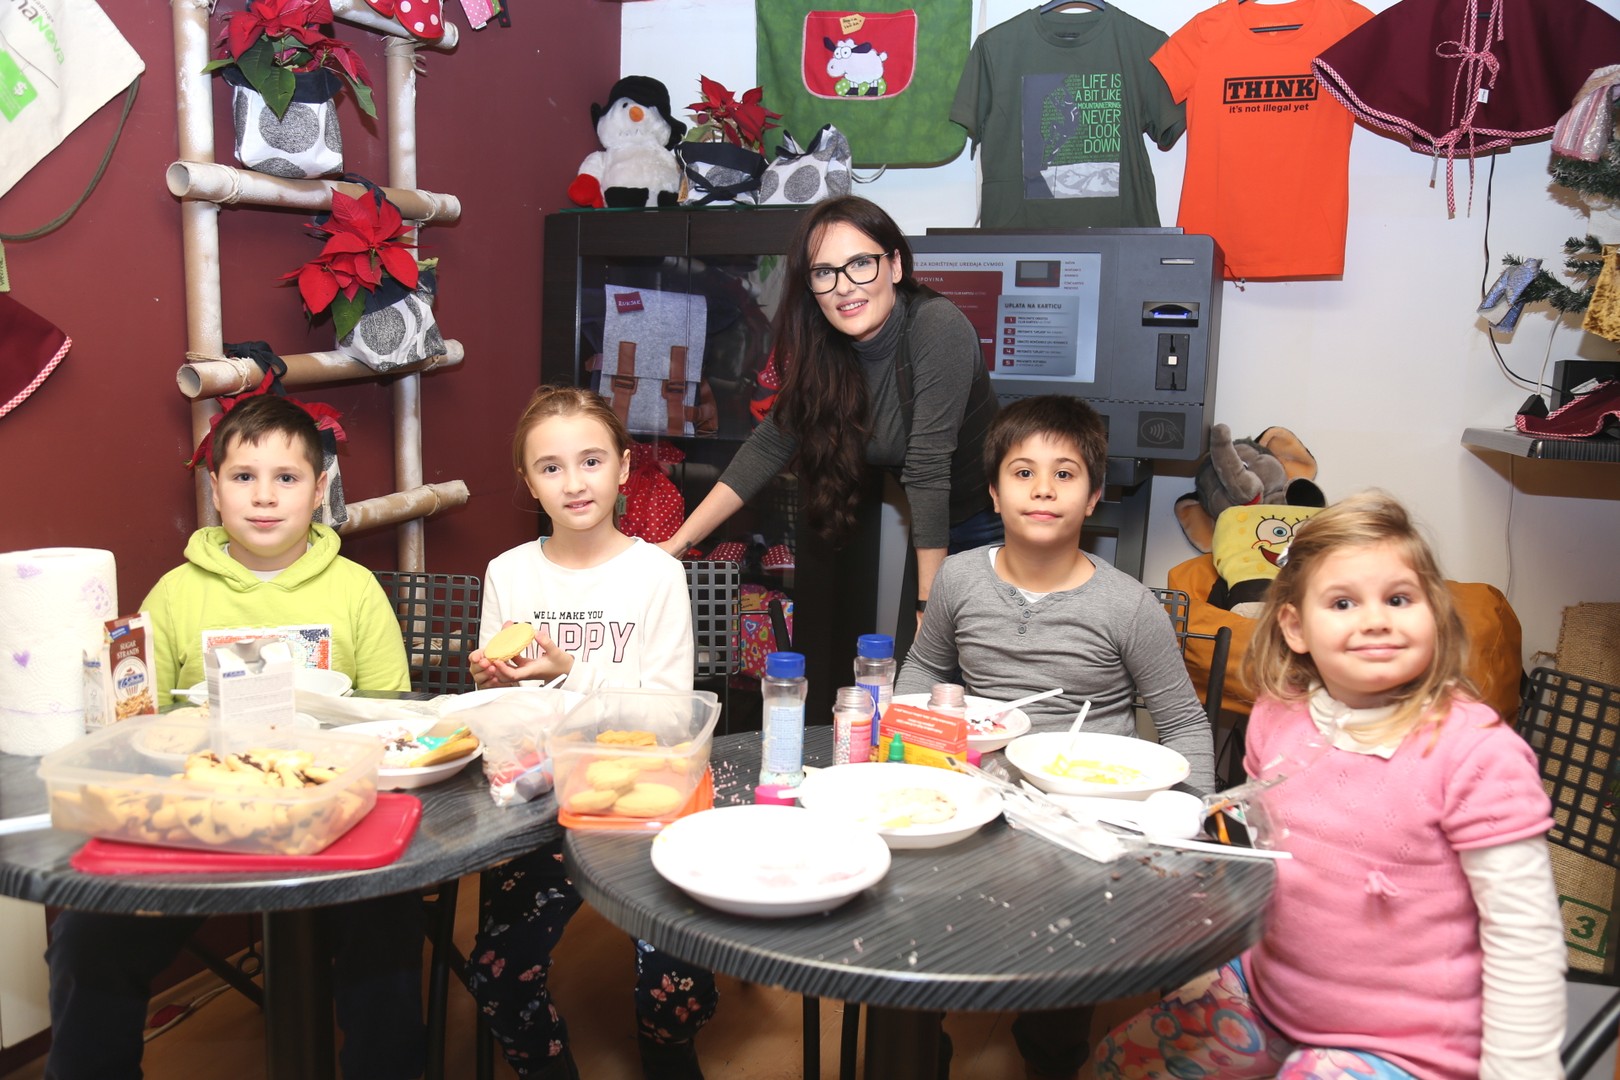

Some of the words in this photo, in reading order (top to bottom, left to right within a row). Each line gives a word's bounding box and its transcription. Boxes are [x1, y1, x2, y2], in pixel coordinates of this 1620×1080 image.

[1082, 74, 1108, 89] LIFE
[1111, 73, 1122, 88] IS
[1075, 90, 1082, 101] A
[1084, 89, 1100, 101] BIT
[1101, 89, 1122, 101] LIKE
[1228, 79, 1314, 99] THINK
[1229, 105, 1243, 113] it's
[1263, 103, 1291, 113] illegal
[1293, 103, 1309, 113] yet
[1082, 109, 1121, 124] NEVER
[1088, 124, 1121, 139] LOOK
[1084, 138, 1120, 154] DOWN
[559, 611, 585, 620] MAKE
[587, 610, 604, 619] YOU
[513, 621, 636, 663] APPY
[1570, 915, 1596, 939] 3
